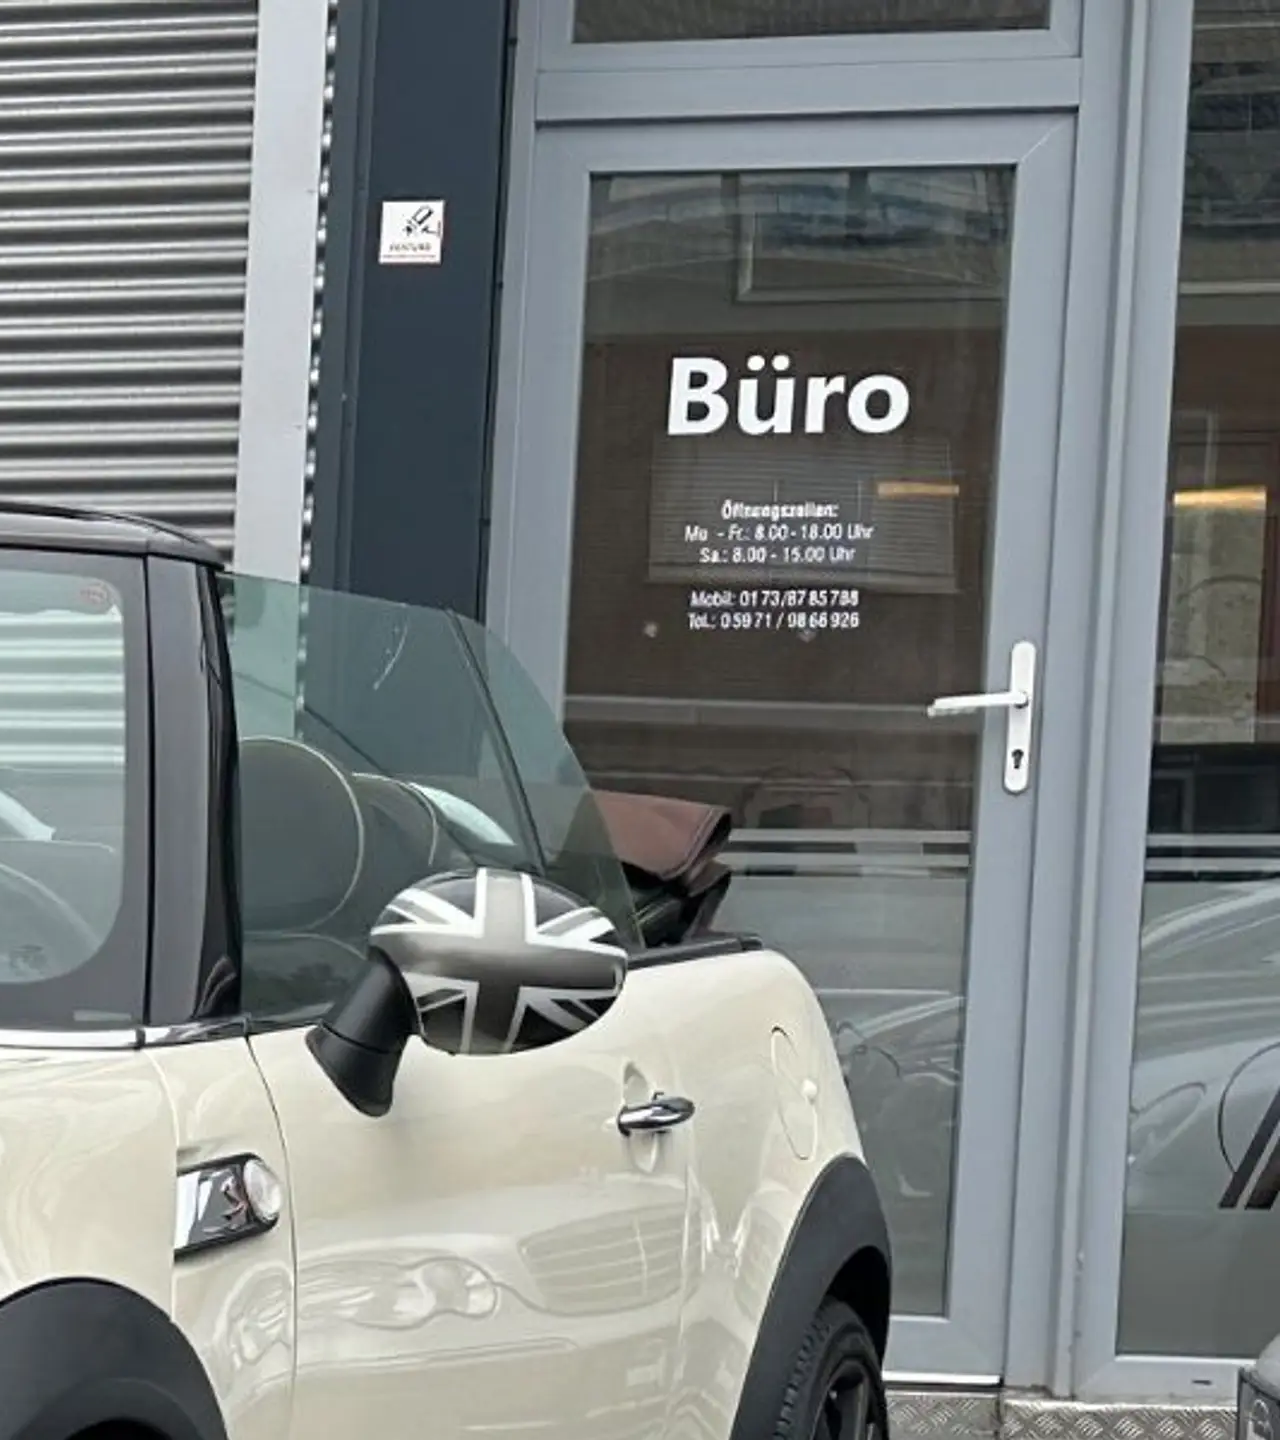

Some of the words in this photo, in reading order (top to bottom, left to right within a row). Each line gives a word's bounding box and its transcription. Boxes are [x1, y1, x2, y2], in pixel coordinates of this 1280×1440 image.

[667, 354, 910, 436] Büro
[754, 523, 788, 541] 8.00
[801, 522, 843, 541] 18.00
[847, 522, 874, 540] Uhr
[732, 546, 767, 563] 8.00
[828, 545, 856, 563] Uhr
[690, 590, 736, 607] Mobil:
